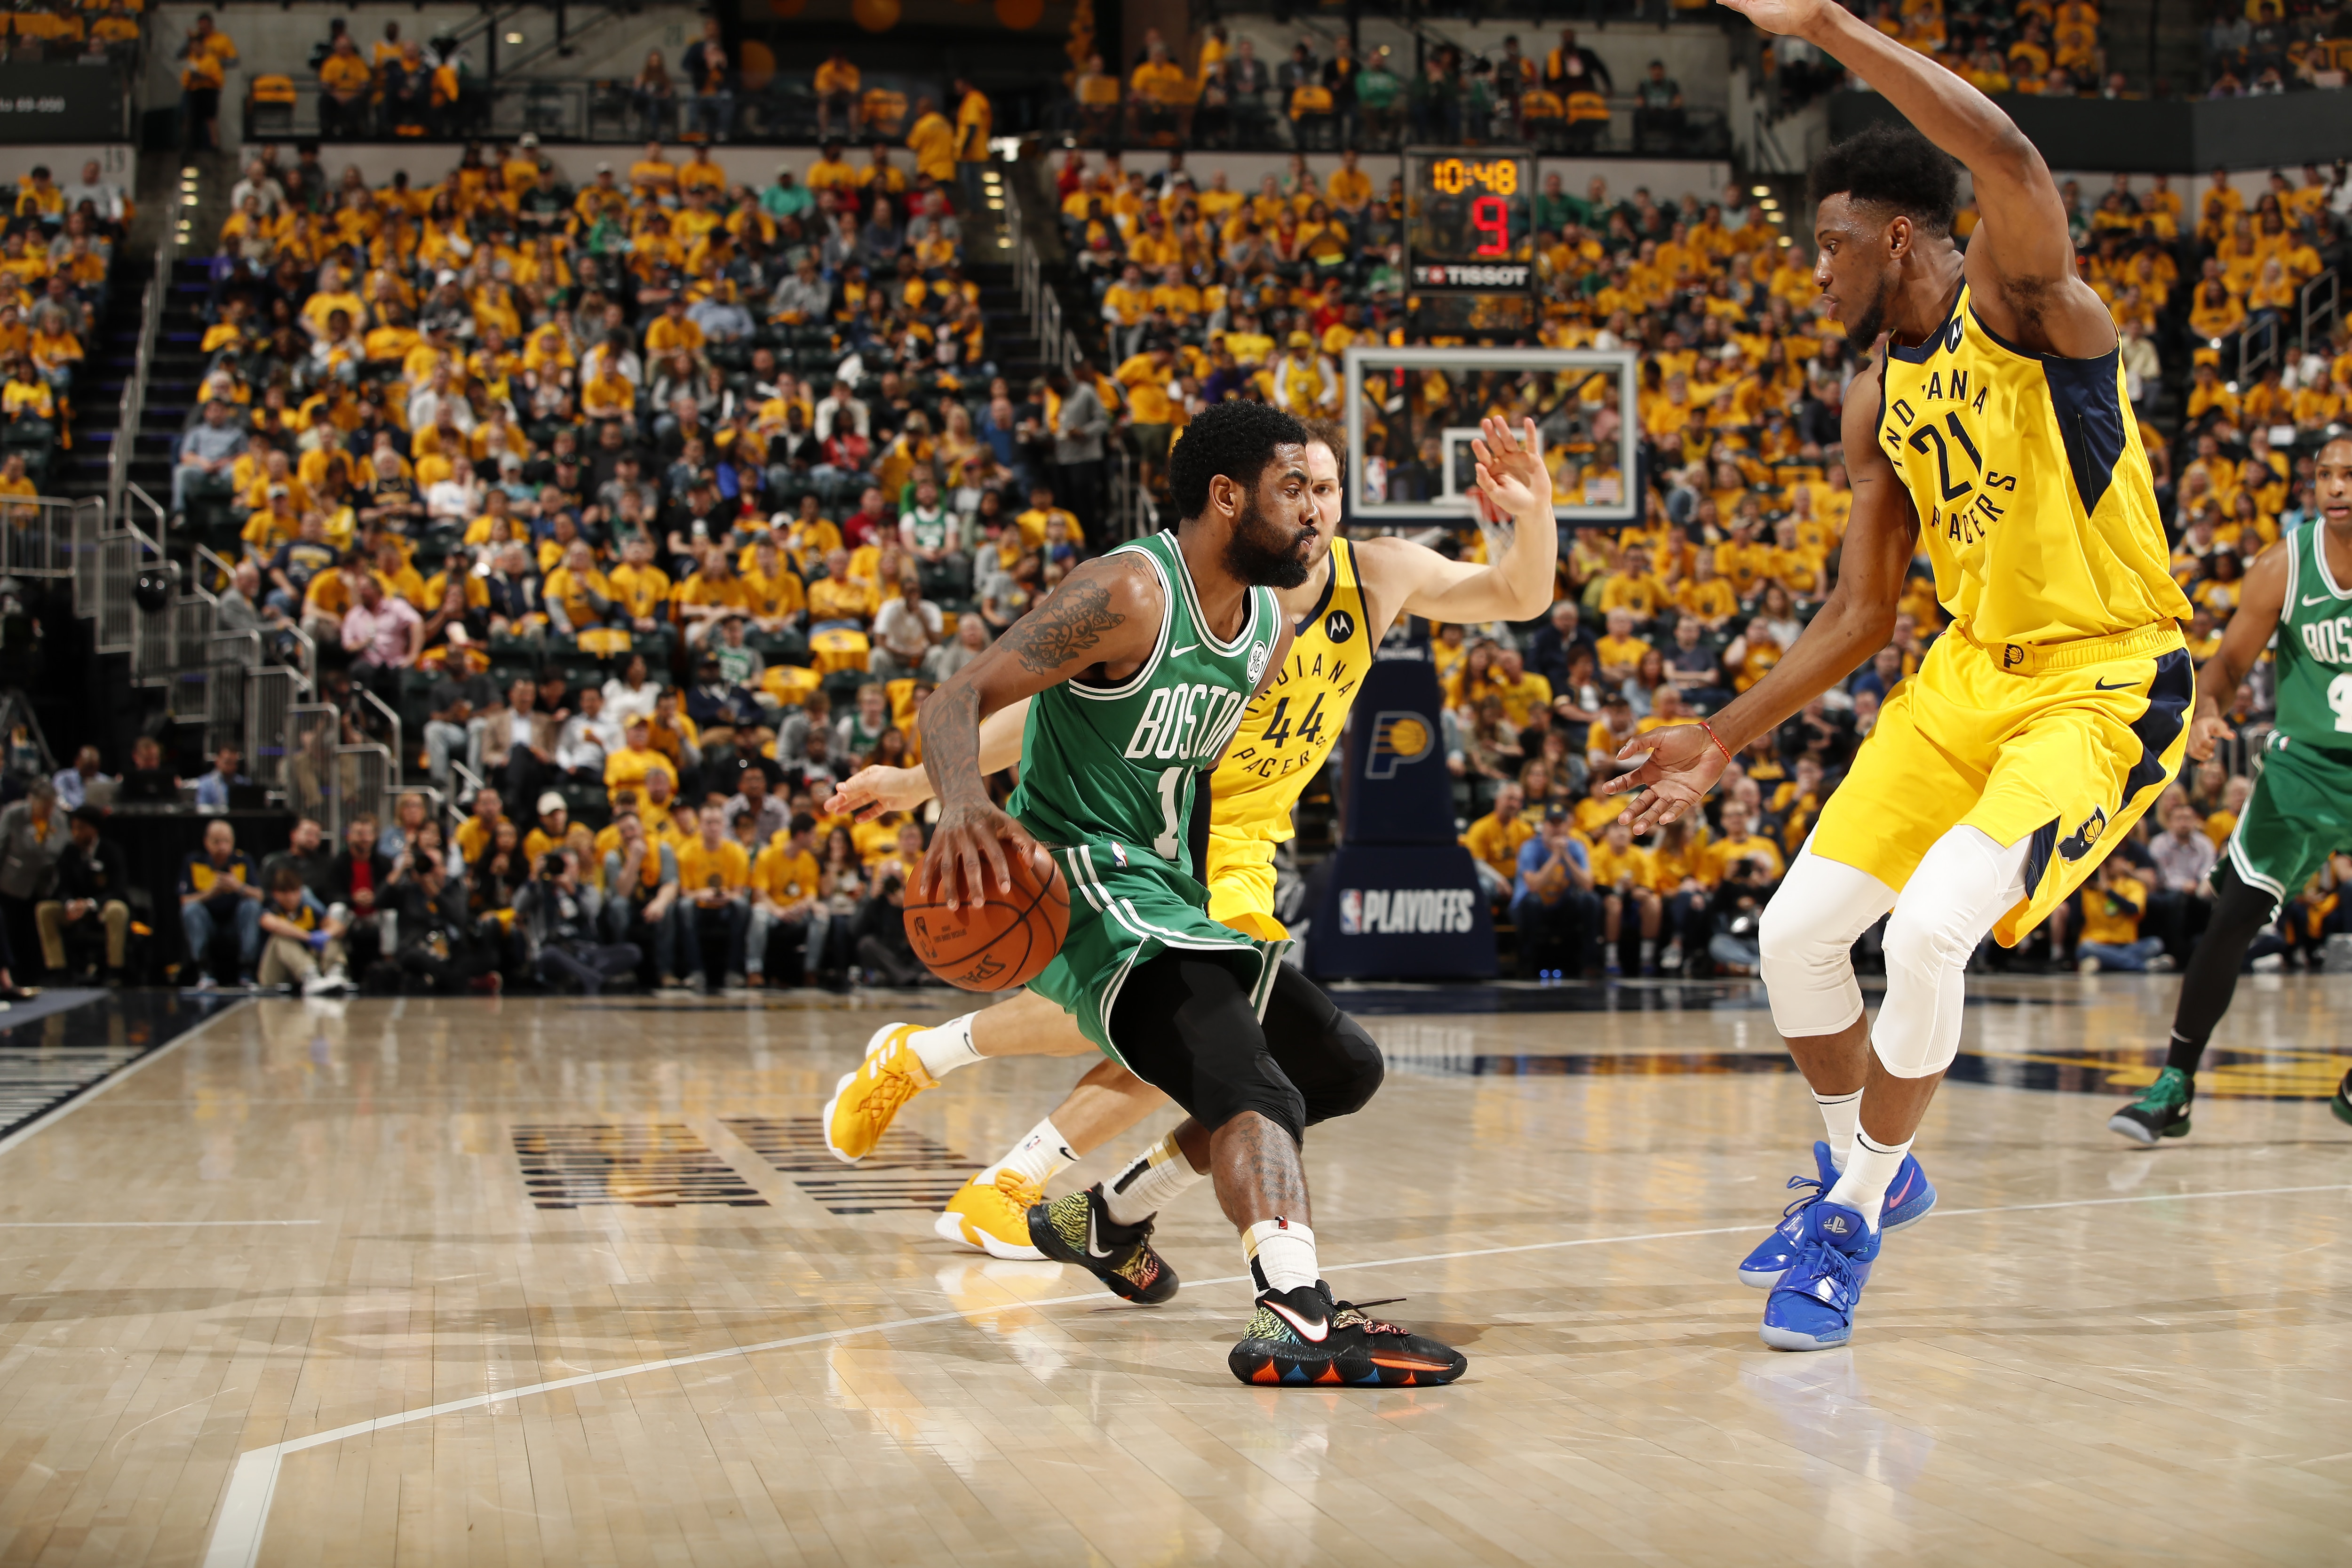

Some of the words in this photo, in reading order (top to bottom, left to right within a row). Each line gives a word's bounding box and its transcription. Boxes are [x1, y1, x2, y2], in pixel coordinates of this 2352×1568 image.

[1433, 158, 1518, 195] 10:48
[1472, 196, 1509, 255] 9
[1447, 265, 1529, 286] TISSOT
[1887, 368, 1988, 468] INDANA
[1908, 411, 1982, 502] 21
[1931, 471, 2017, 544] PACERS
[1125, 683, 1249, 760] BOSTON
[1261, 692, 1326, 748] 44
[1232, 735, 1327, 778] PACERS
[1362, 889, 1475, 934] PLAYOFFS
